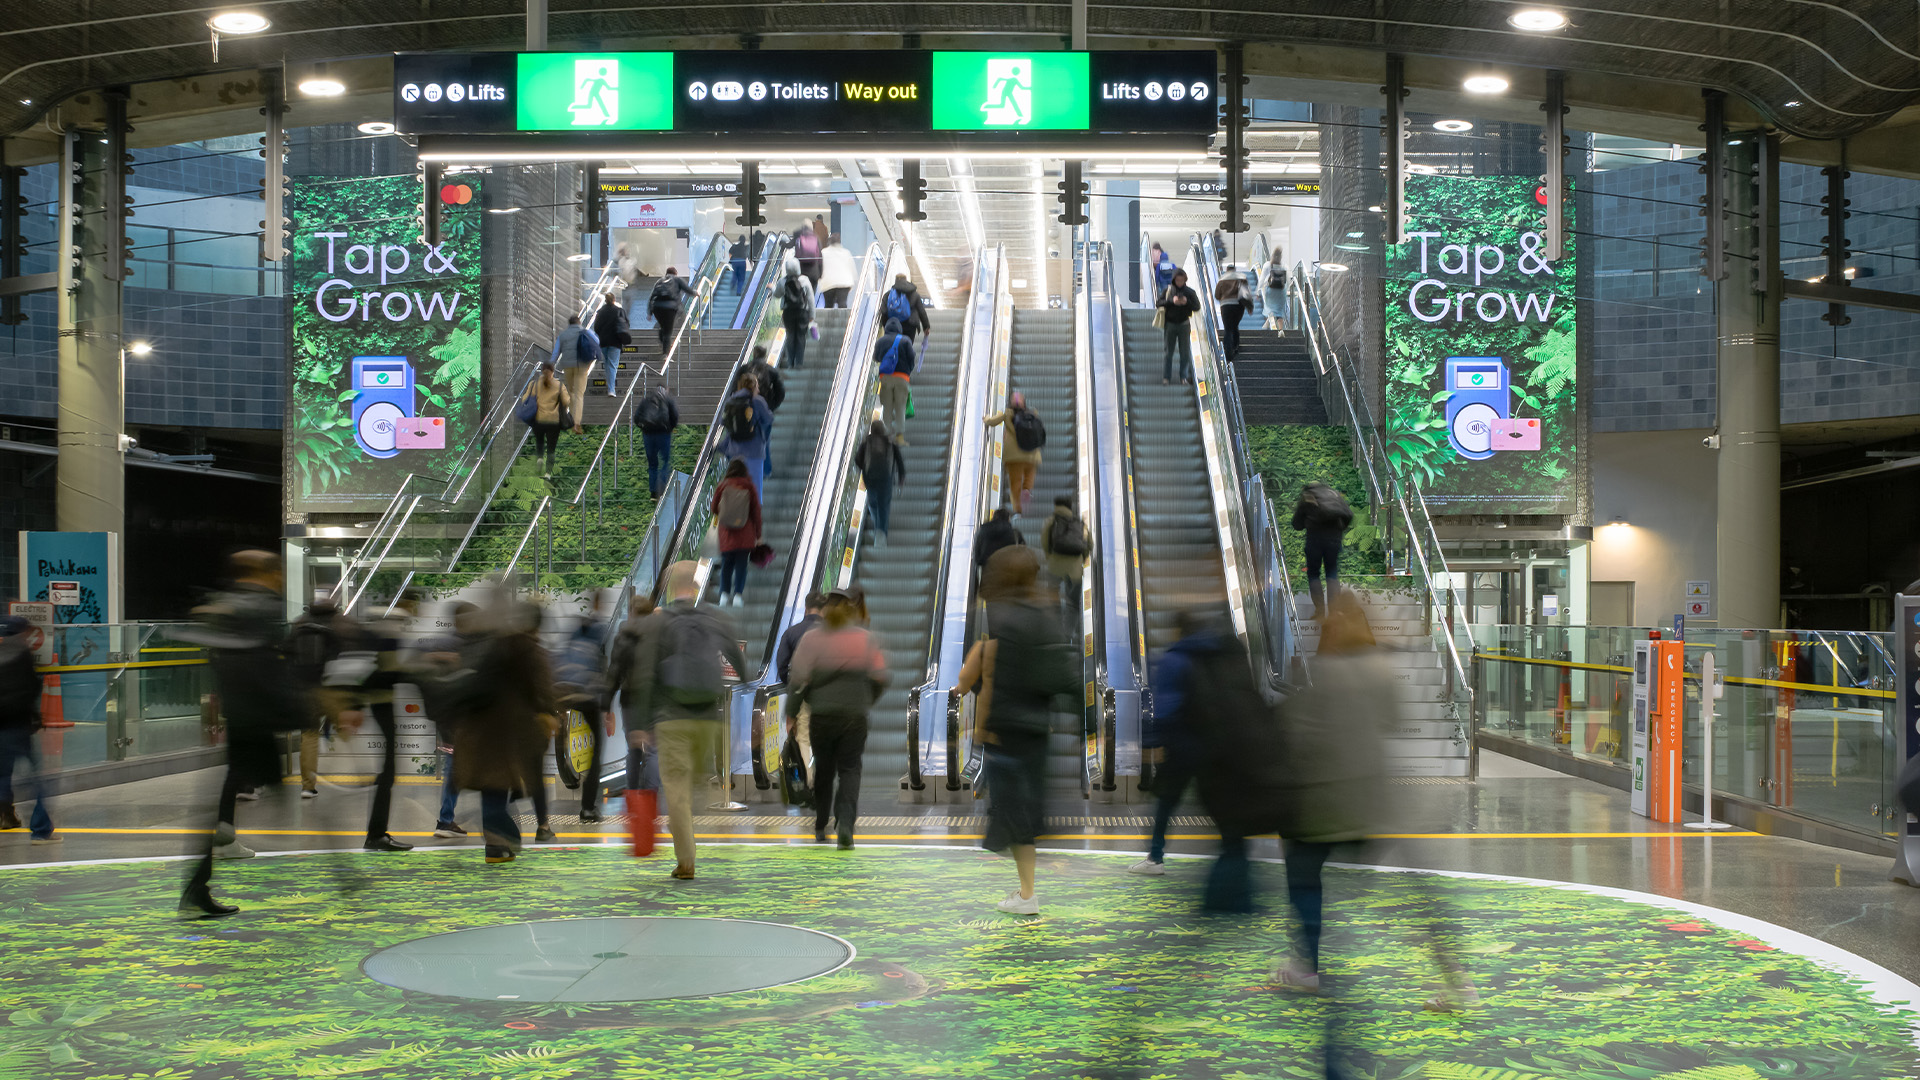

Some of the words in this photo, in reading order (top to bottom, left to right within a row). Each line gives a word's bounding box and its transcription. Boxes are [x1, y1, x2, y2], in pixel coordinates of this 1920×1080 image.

[469, 84, 505, 100] Lifts
[771, 83, 828, 99] Toilets
[845, 84, 883, 101] Way
[888, 84, 917, 98] out
[1103, 83, 1140, 99] Lifts
[601, 184, 617, 193] Way
[1296, 184, 1312, 192] Way
[314, 232, 410, 285] Tap
[423, 239, 460, 275] &
[1407, 231, 1506, 286] Tap
[1517, 231, 1555, 276] &
[315, 279, 461, 322] Grow
[1408, 279, 1556, 323] Grow
[435, 620, 452, 629] Step
[399, 722, 427, 730] restore
[367, 741, 398, 749] 130,00
[400, 741, 420, 749] trees
